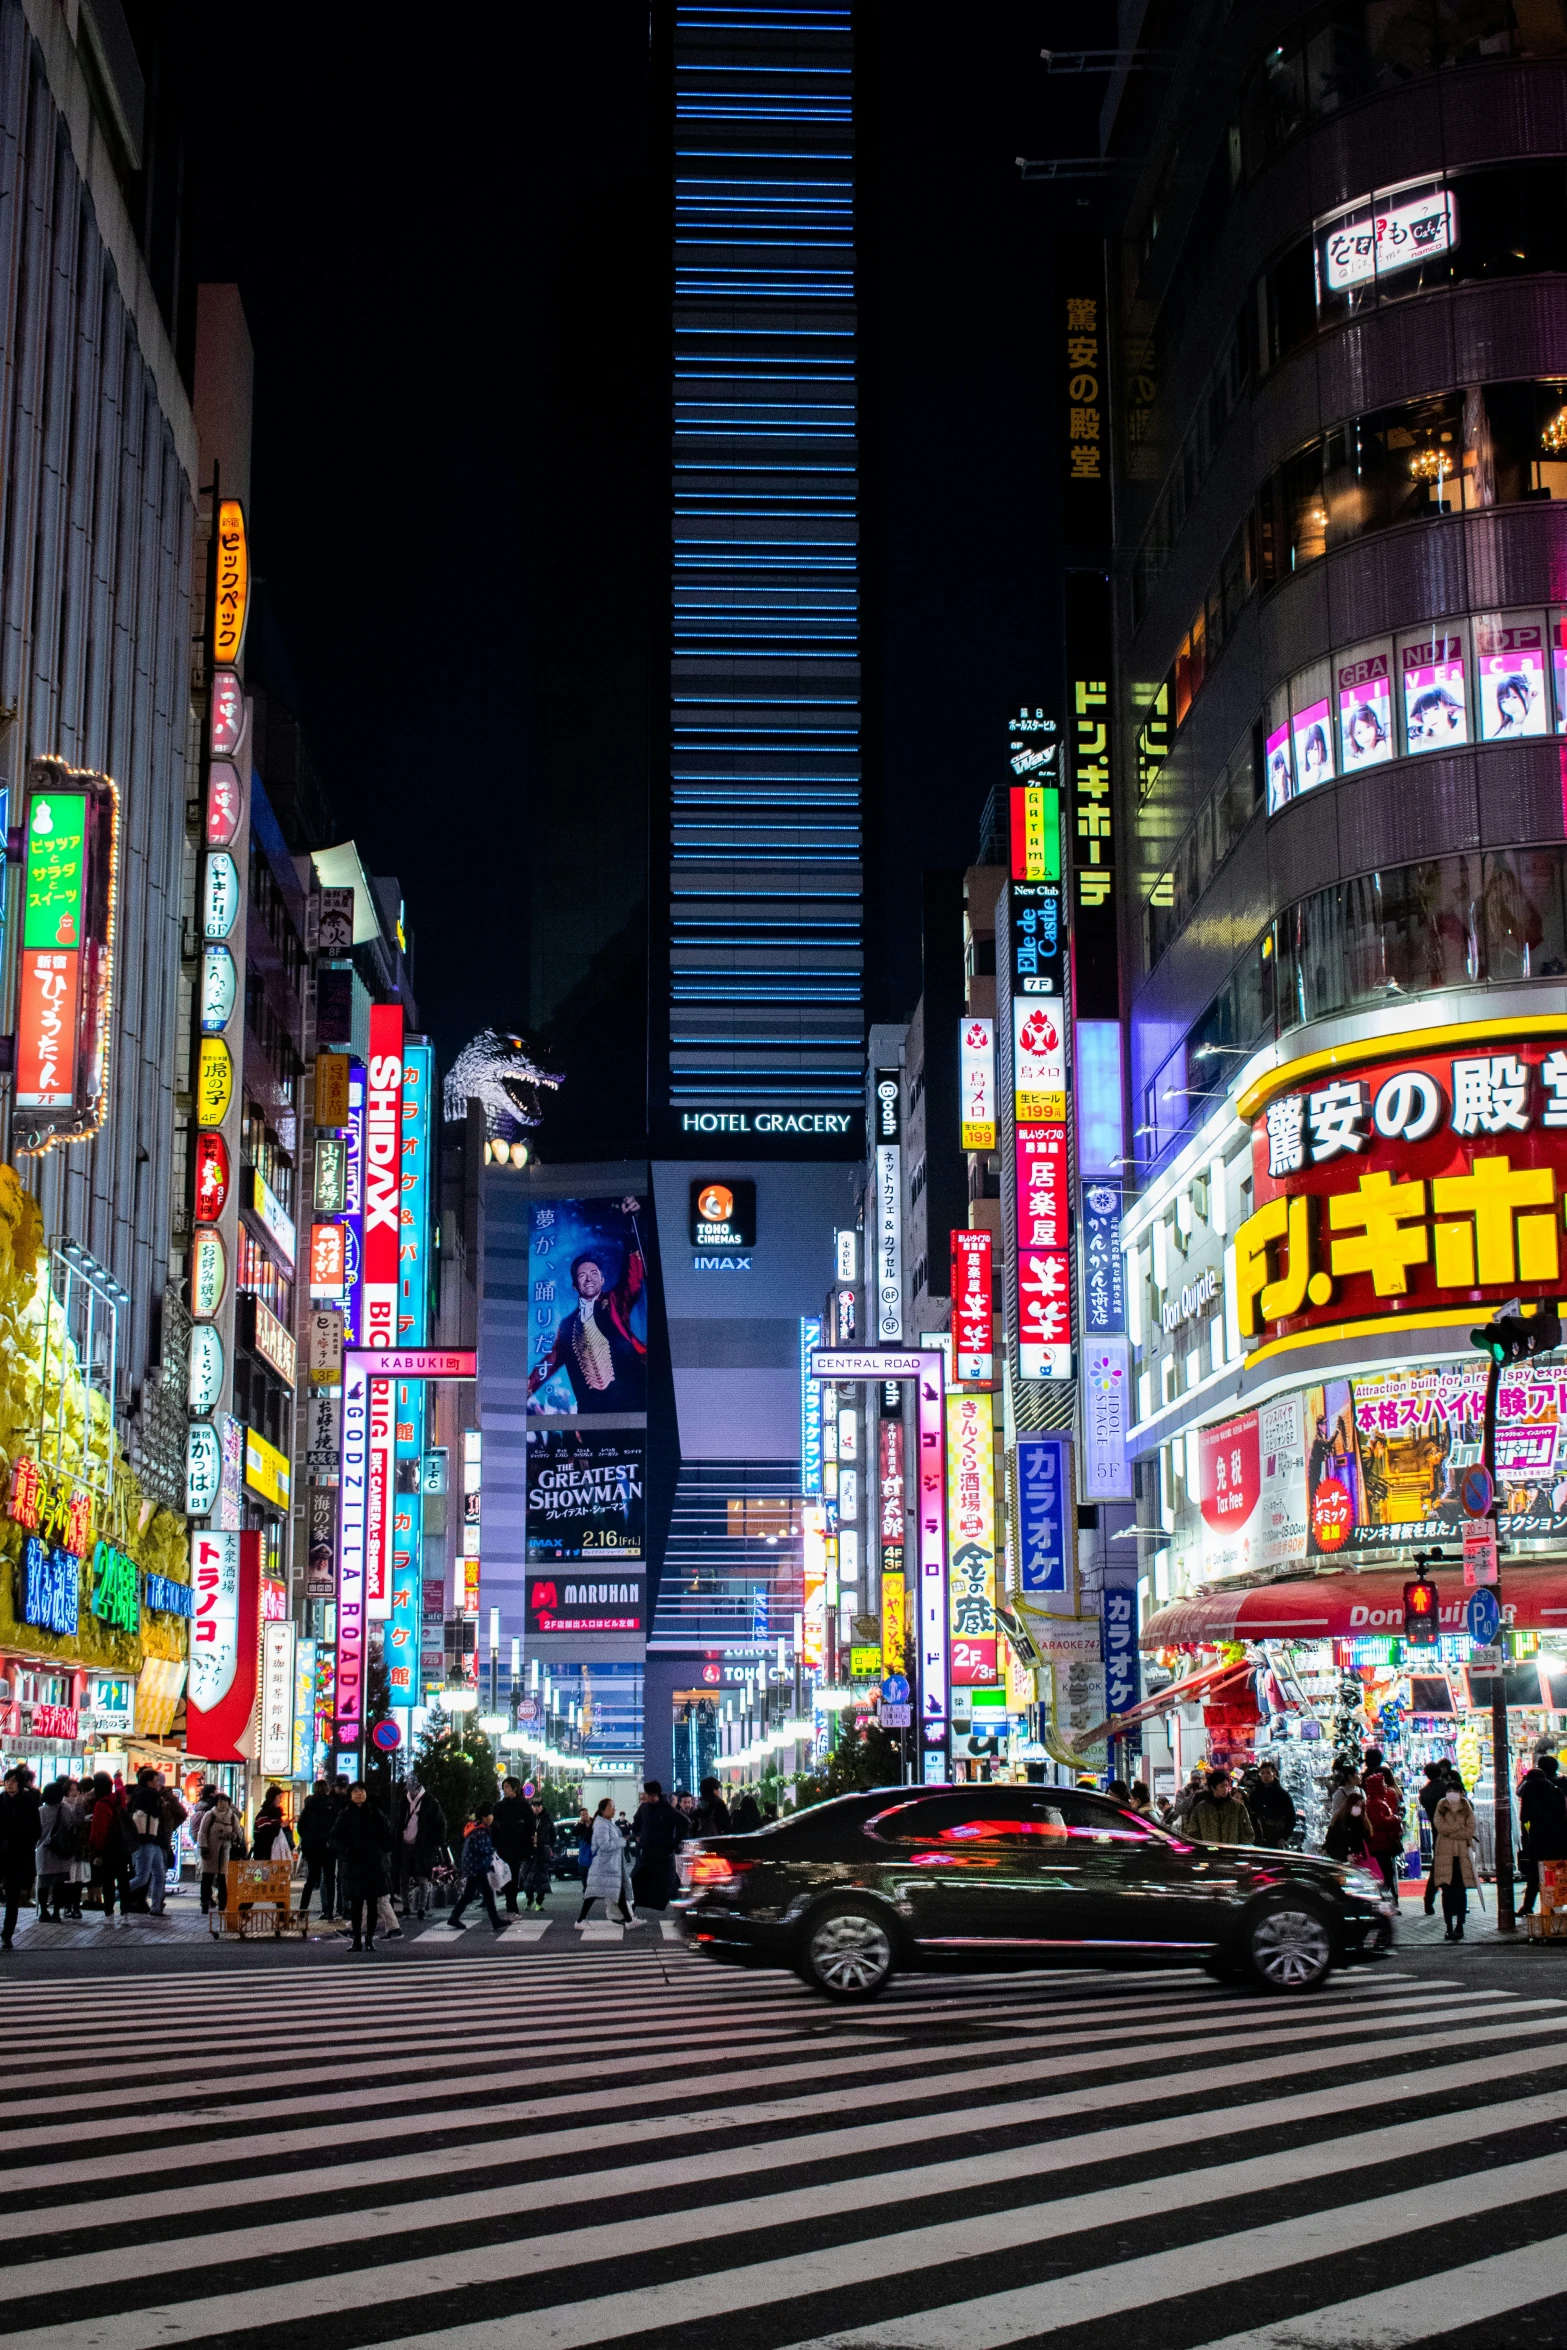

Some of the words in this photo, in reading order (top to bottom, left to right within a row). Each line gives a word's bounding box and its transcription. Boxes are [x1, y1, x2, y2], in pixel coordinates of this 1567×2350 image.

[1411, 243, 1442, 258] namco
[1067, 298, 1101, 478] 驚安の殿堂
[222, 518, 240, 528] 新宿
[218, 533, 240, 647] ピックペック
[214, 692, 239, 735] つぼ八
[1012, 744, 1057, 775] Way
[210, 781, 237, 825] つぼ八
[1028, 793, 1043, 860] Garam
[210, 834, 229, 843] 7F
[50, 855, 60, 864] と
[32, 862, 77, 882] サラダ
[1019, 867, 1053, 877] ガラム
[49, 880, 58, 890] と
[212, 869, 226, 915] ヤキトリ
[1014, 886, 1036, 896] New
[1037, 886, 1059, 896] Club
[29, 889, 77, 908] スイーツ
[207, 923, 228, 936] 6F
[1018, 908, 1037, 934] de
[1038, 899, 1057, 958] Castle
[36, 955, 67, 970] 新宿
[328, 948, 341, 957] 8F
[1018, 935, 1037, 974] Elle
[1027, 980, 1049, 990] 7F
[33, 969, 68, 1090] ひょうたん
[207, 1020, 221, 1029] 5F
[1020, 1065, 1060, 1079] 鳥メロ
[204, 1062, 228, 1106] 虎の子
[328, 1063, 344, 1117] 鳥貴族
[970, 1071, 986, 1118] 鳥メロ
[37, 1094, 55, 1105] 7F
[877, 1080, 899, 1136] Booth
[1020, 1094, 1061, 1104] 生ビール
[201, 1113, 217, 1122] 4F
[683, 1114, 751, 1132] HOTEL
[755, 1114, 851, 1132] GRACERY
[1026, 1105, 1053, 1118] 199
[367, 1055, 401, 1232] SHIDAX
[968, 1131, 992, 1143] 199
[1018, 1129, 1064, 1140] 新しいタイプの
[320, 1143, 339, 1201] 山内農場
[883, 1152, 895, 1214] ネットカフェ
[324, 1200, 335, 1209] 5F
[1028, 1162, 1057, 1246] 居楽屋
[697, 1224, 730, 1235] TOHO
[884, 1220, 895, 1231] &
[697, 1234, 742, 1244] CINEMAS
[958, 1234, 991, 1243] 新しいタイプの
[395, 1067, 420, 1441] カラオケ&パーテー館
[694, 1257, 751, 1270] IMAX
[842, 1240, 851, 1276] 東京ビル
[884, 1236, 895, 1279] カプセル
[200, 1244, 215, 1308] お好み焼き
[967, 1253, 981, 1292] 居楽屋
[1088, 1217, 1109, 1325] かんかん商店
[533, 1208, 556, 1395] 夢が、踊りだす。
[1162, 1300, 1180, 1335] Don
[1181, 1266, 1217, 1318] Quijote
[369, 1301, 391, 1347] BIC
[199, 1344, 213, 1401] とらそば
[817, 1358, 879, 1368] CENTRAL
[884, 1358, 921, 1368] ROAD
[317, 1370, 334, 1381] 3F
[1355, 1383, 1407, 1398] Attraction
[1411, 1378, 1438, 1390] built
[1441, 1375, 1459, 1387] for
[1463, 1376, 1471, 1384] a
[1507, 1368, 1531, 1381] spy
[194, 1404, 210, 1415] 1F
[1096, 1394, 1108, 1446] STAGE
[1108, 1394, 1120, 1437] IDOL
[1264, 1405, 1294, 1425] インスパイヤ
[191, 1431, 211, 1439] 新宿
[1265, 1419, 1294, 1439] ヒューマックス
[189, 1440, 211, 1491] かっぱ
[370, 1451, 385, 1473] BIC
[556, 1463, 575, 1472] THE
[960, 1400, 981, 1513] きんくら酒場
[538, 1464, 639, 1489] GREATEST
[1097, 1462, 1120, 1478] 5F
[1216, 1449, 1242, 1492] 免税
[191, 1498, 208, 1508] B1
[344, 1405, 364, 1581] GODZILLA
[529, 1481, 643, 1510] SHOWMAN
[1216, 1495, 1229, 1515] Tax
[1229, 1491, 1244, 1509] Free
[1315, 1491, 1348, 1509] レーザー
[313, 1495, 331, 1541] 海の家
[545, 1501, 627, 1520] グレイテスト・ショーマン
[881, 1475, 904, 1538] 甘太郎
[1025, 1448, 1061, 1586] カラオケ
[1315, 1507, 1348, 1525] ギミック
[961, 1514, 978, 1523] KIN
[529, 1538, 564, 1548] IMAX
[582, 1530, 618, 1547] 2.16
[961, 1527, 982, 1537] KURA
[1321, 1524, 1341, 1541] 追加
[883, 1546, 903, 1558] 4F
[922, 1431, 940, 1665] ゴジラロード
[222, 1534, 236, 1594] 大衆酒場
[883, 1558, 903, 1570] 3F
[196, 1541, 220, 1643] トラノコ
[390, 1511, 412, 1687] カラオケ館
[564, 1583, 639, 1604] MARUHAN
[952, 1541, 995, 1635] 金の蔵
[543, 1619, 635, 1629] 2F店舗出入口はビル左側
[1349, 1604, 1404, 1627] Don
[1473, 1602, 1486, 1637] P
[1483, 1620, 1492, 1636] 40
[340, 1602, 360, 1688] ROAD
[1107, 1595, 1133, 1707] カラオケ
[211, 1644, 231, 1686] やきとり
[271, 1658, 285, 1716] 珈琲茶館
[95, 1719, 131, 1730] 虎の子
[268, 1723, 286, 1741] 集
